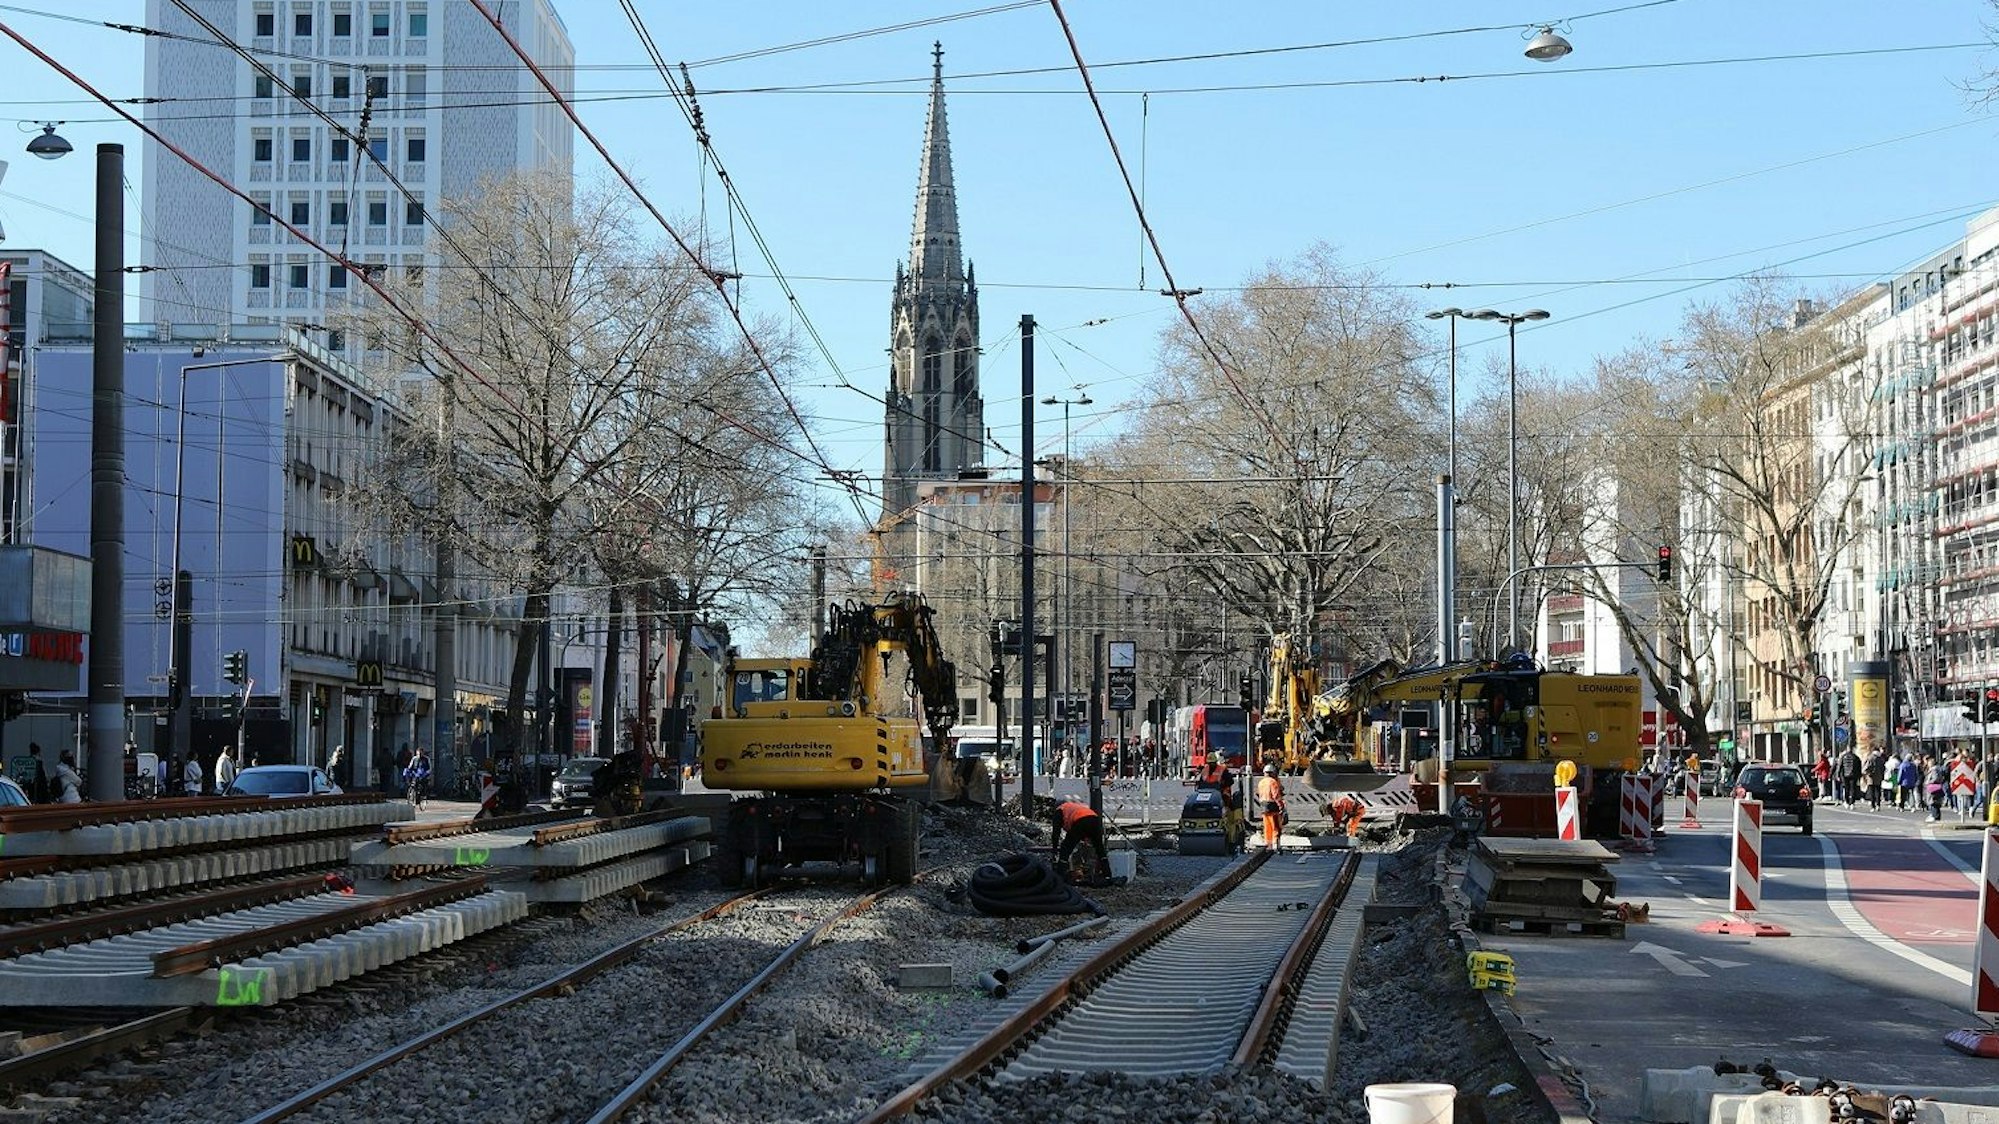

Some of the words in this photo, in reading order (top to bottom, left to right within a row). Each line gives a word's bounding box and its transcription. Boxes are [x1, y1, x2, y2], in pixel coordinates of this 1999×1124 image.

[1577, 684, 1624, 694] LEONHARD
[765, 751, 801, 759] martin
[803, 750, 833, 759] henk
[455, 846, 490, 866] LW
[216, 969, 266, 1006] LW
